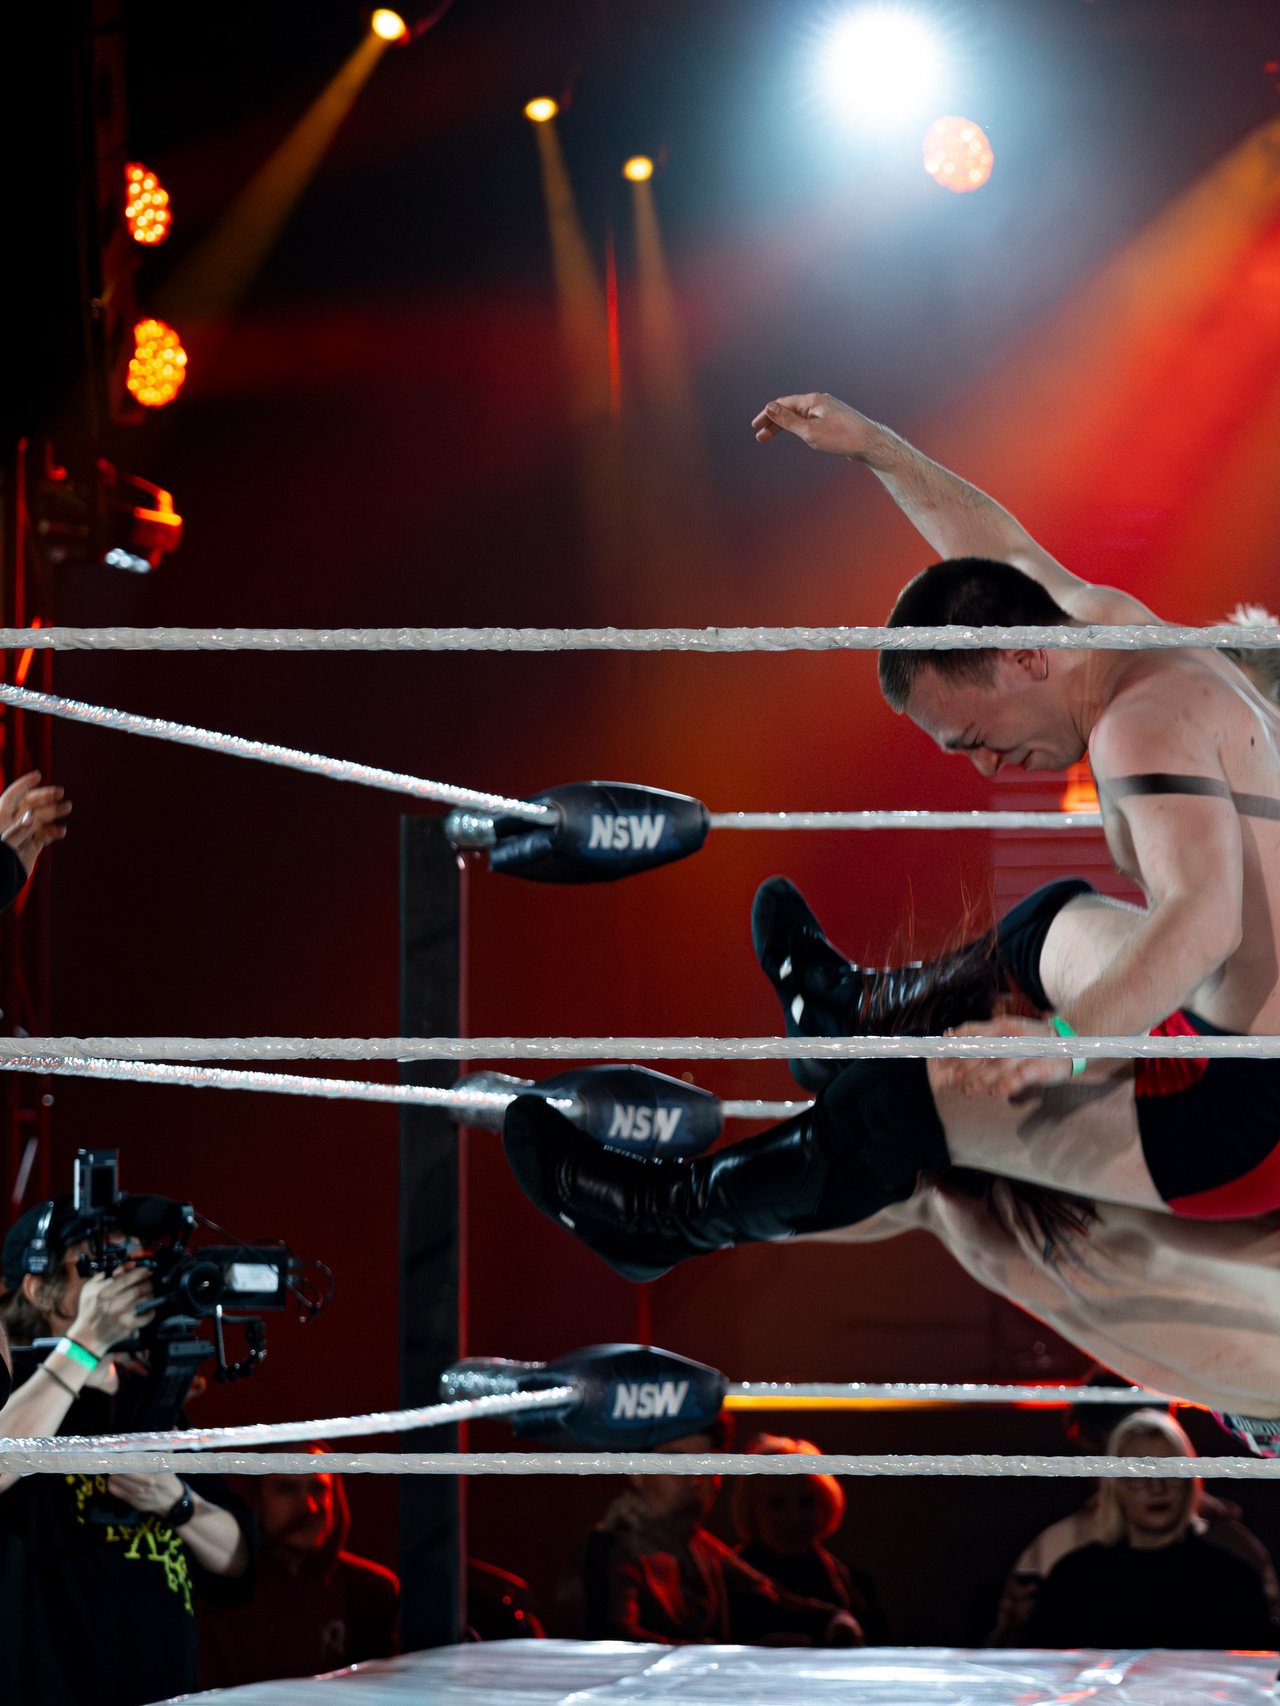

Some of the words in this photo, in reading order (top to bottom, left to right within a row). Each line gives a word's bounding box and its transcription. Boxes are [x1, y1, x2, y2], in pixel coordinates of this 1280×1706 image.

[587, 813, 666, 851] NSW
[607, 1102, 683, 1144] NSW
[611, 1380, 690, 1421] NSW
